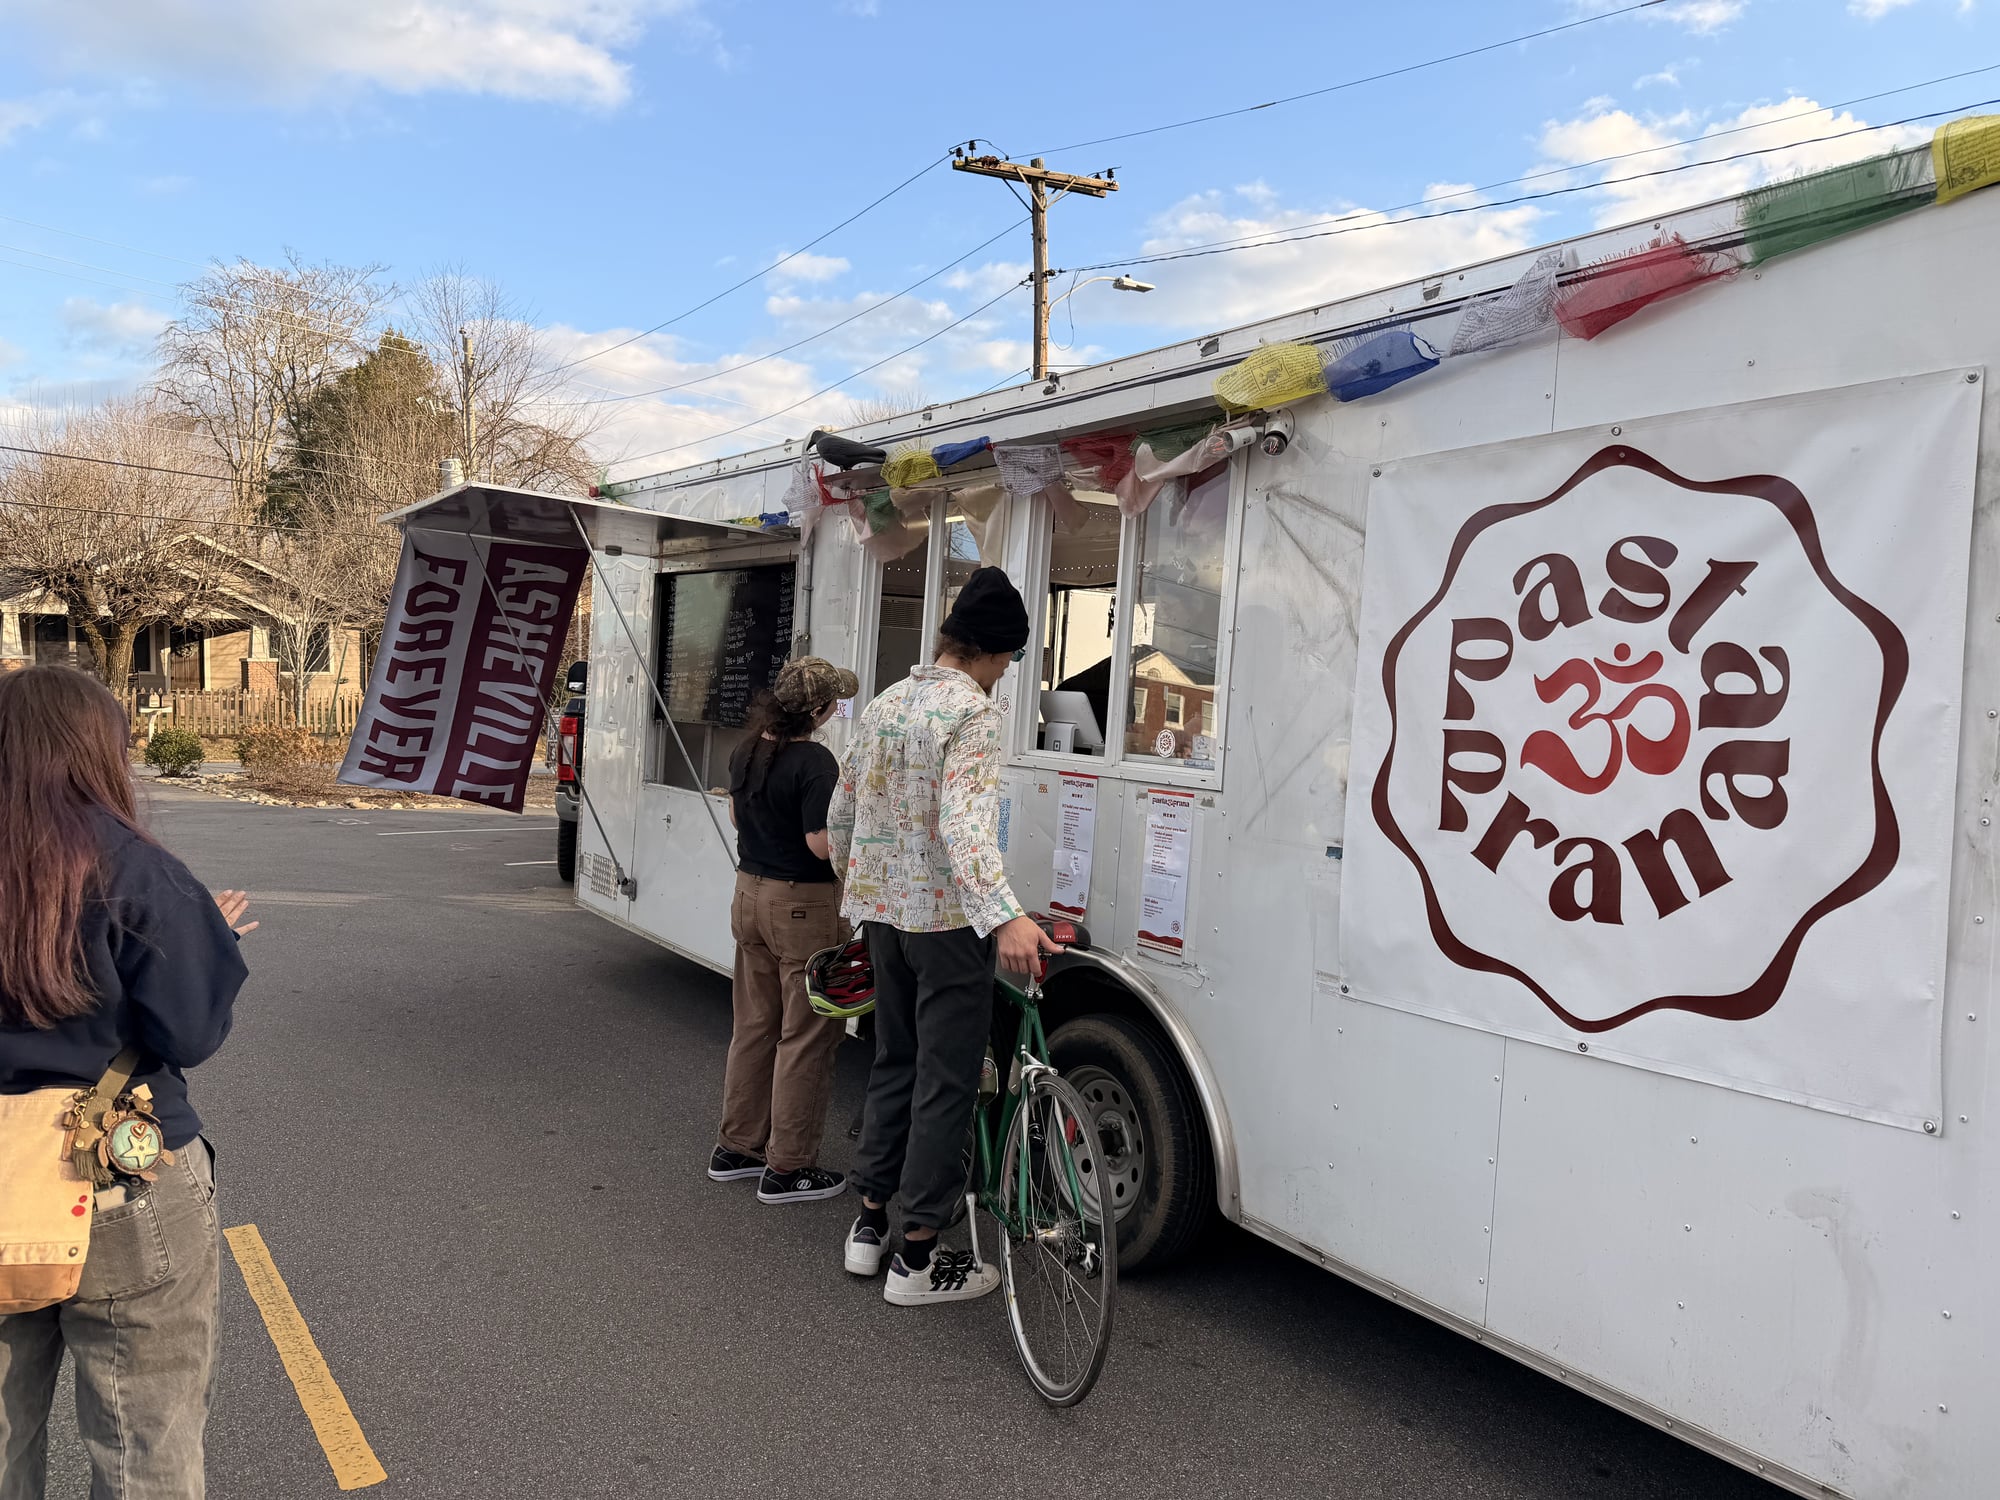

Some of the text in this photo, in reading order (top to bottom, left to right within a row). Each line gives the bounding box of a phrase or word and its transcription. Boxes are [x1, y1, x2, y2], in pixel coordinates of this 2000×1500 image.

[358, 551, 467, 784] FOREVER
[450, 558, 569, 804] ASHEVILLE
[1444, 535, 1790, 731] pasta
[1438, 728, 1791, 926] prana
